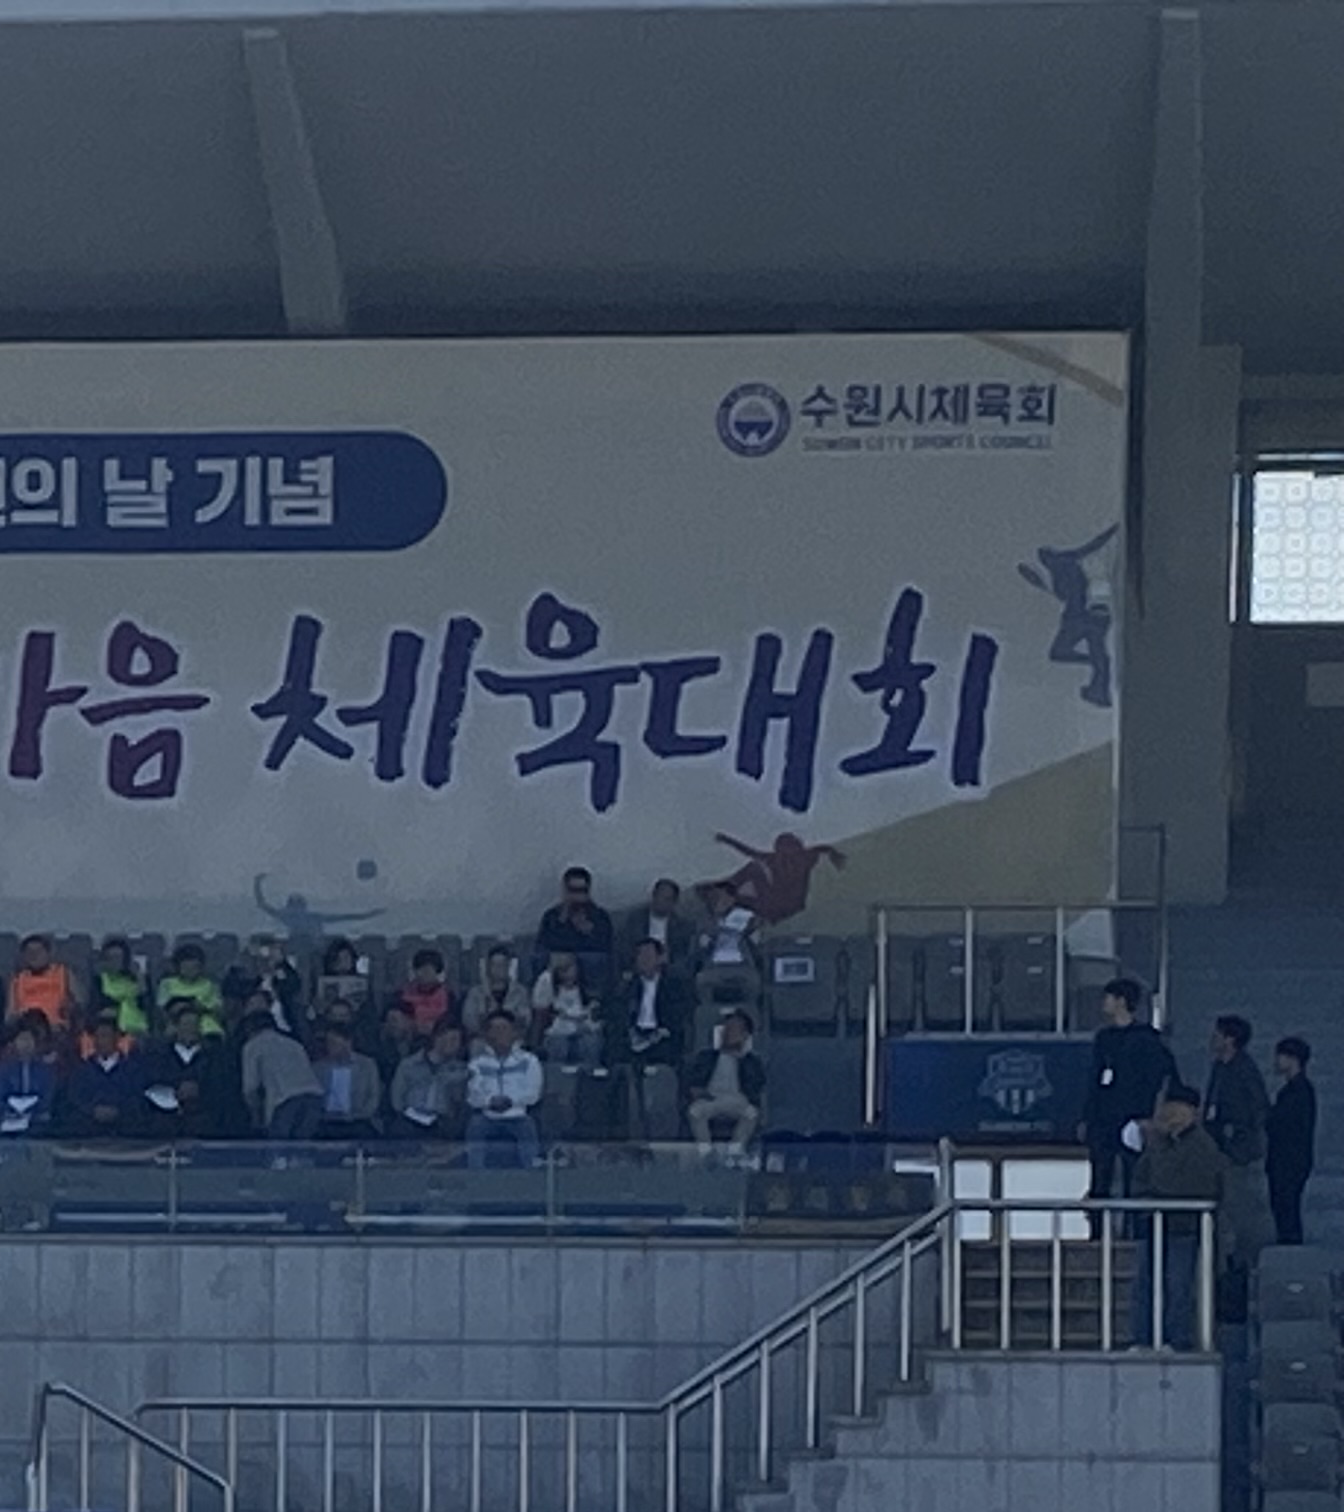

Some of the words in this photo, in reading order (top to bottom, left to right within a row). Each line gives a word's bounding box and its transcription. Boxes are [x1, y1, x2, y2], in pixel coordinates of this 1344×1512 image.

[800, 383, 1058, 428] 수원시체육회
[103, 456, 174, 528] 날
[194, 455, 335, 527] 기념
[250, 586, 998, 814] 체육대회
